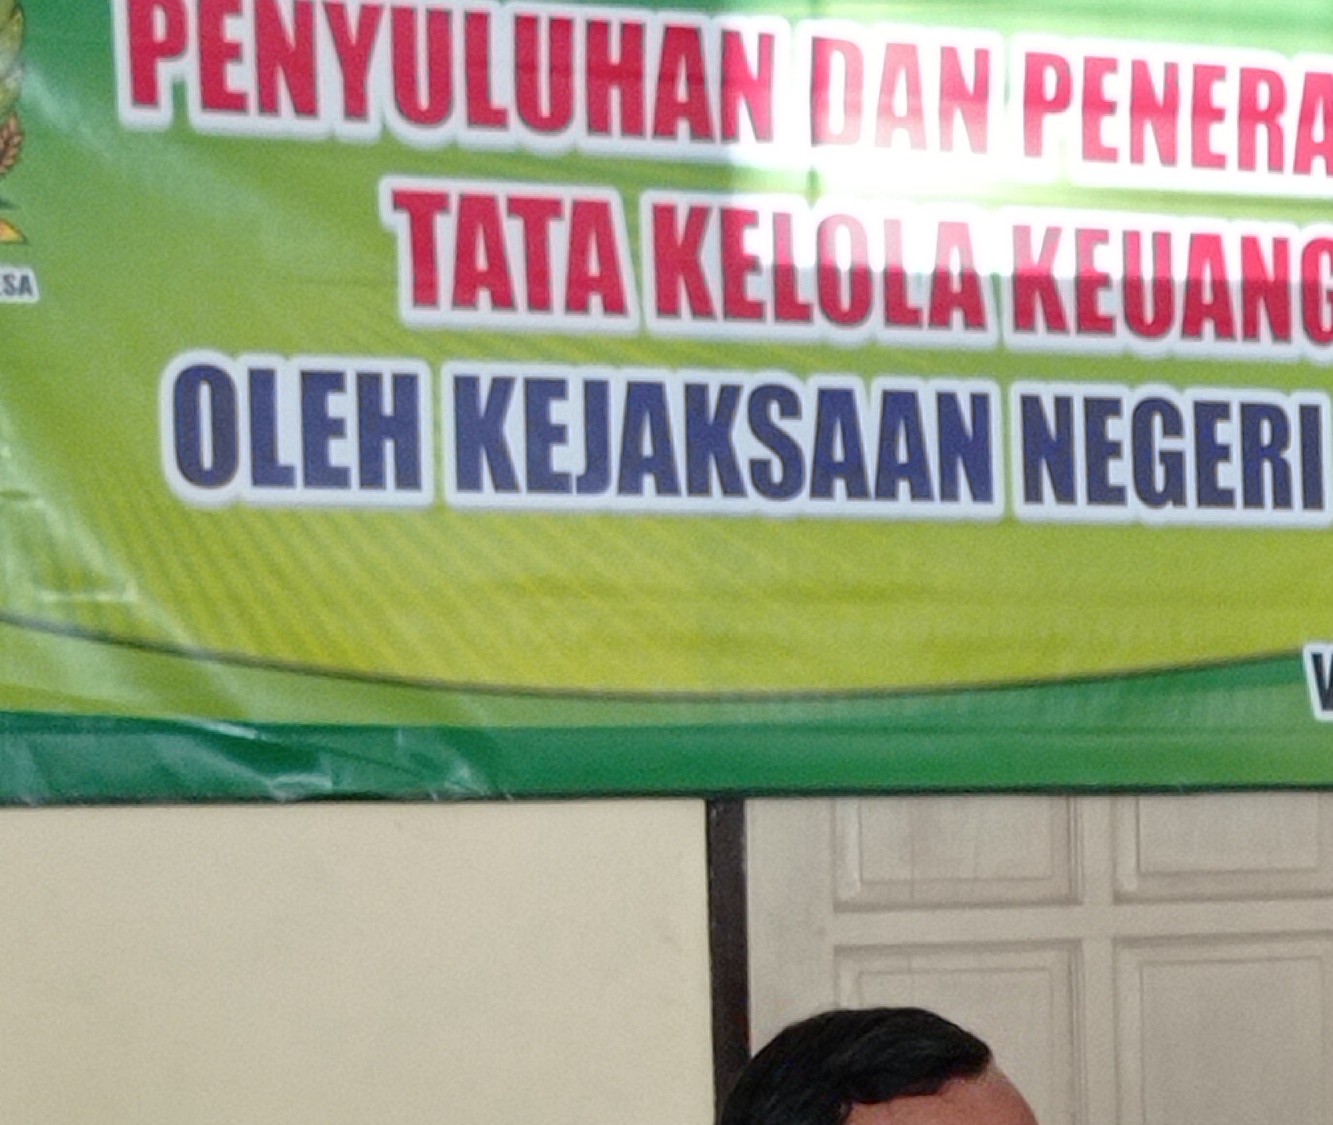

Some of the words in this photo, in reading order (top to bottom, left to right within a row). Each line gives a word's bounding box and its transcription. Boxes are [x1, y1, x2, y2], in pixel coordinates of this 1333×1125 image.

[129, 0, 776, 143] PENYULUHAN
[812, 36, 991, 155] DAN
[0, 273, 33, 297] SA
[393, 189, 629, 315] TATA
[652, 203, 988, 331] KELOLA
[172, 363, 423, 490] OLEH
[452, 374, 992, 504] KEJAKSAAN
[1020, 395, 1325, 514] NEGERI
